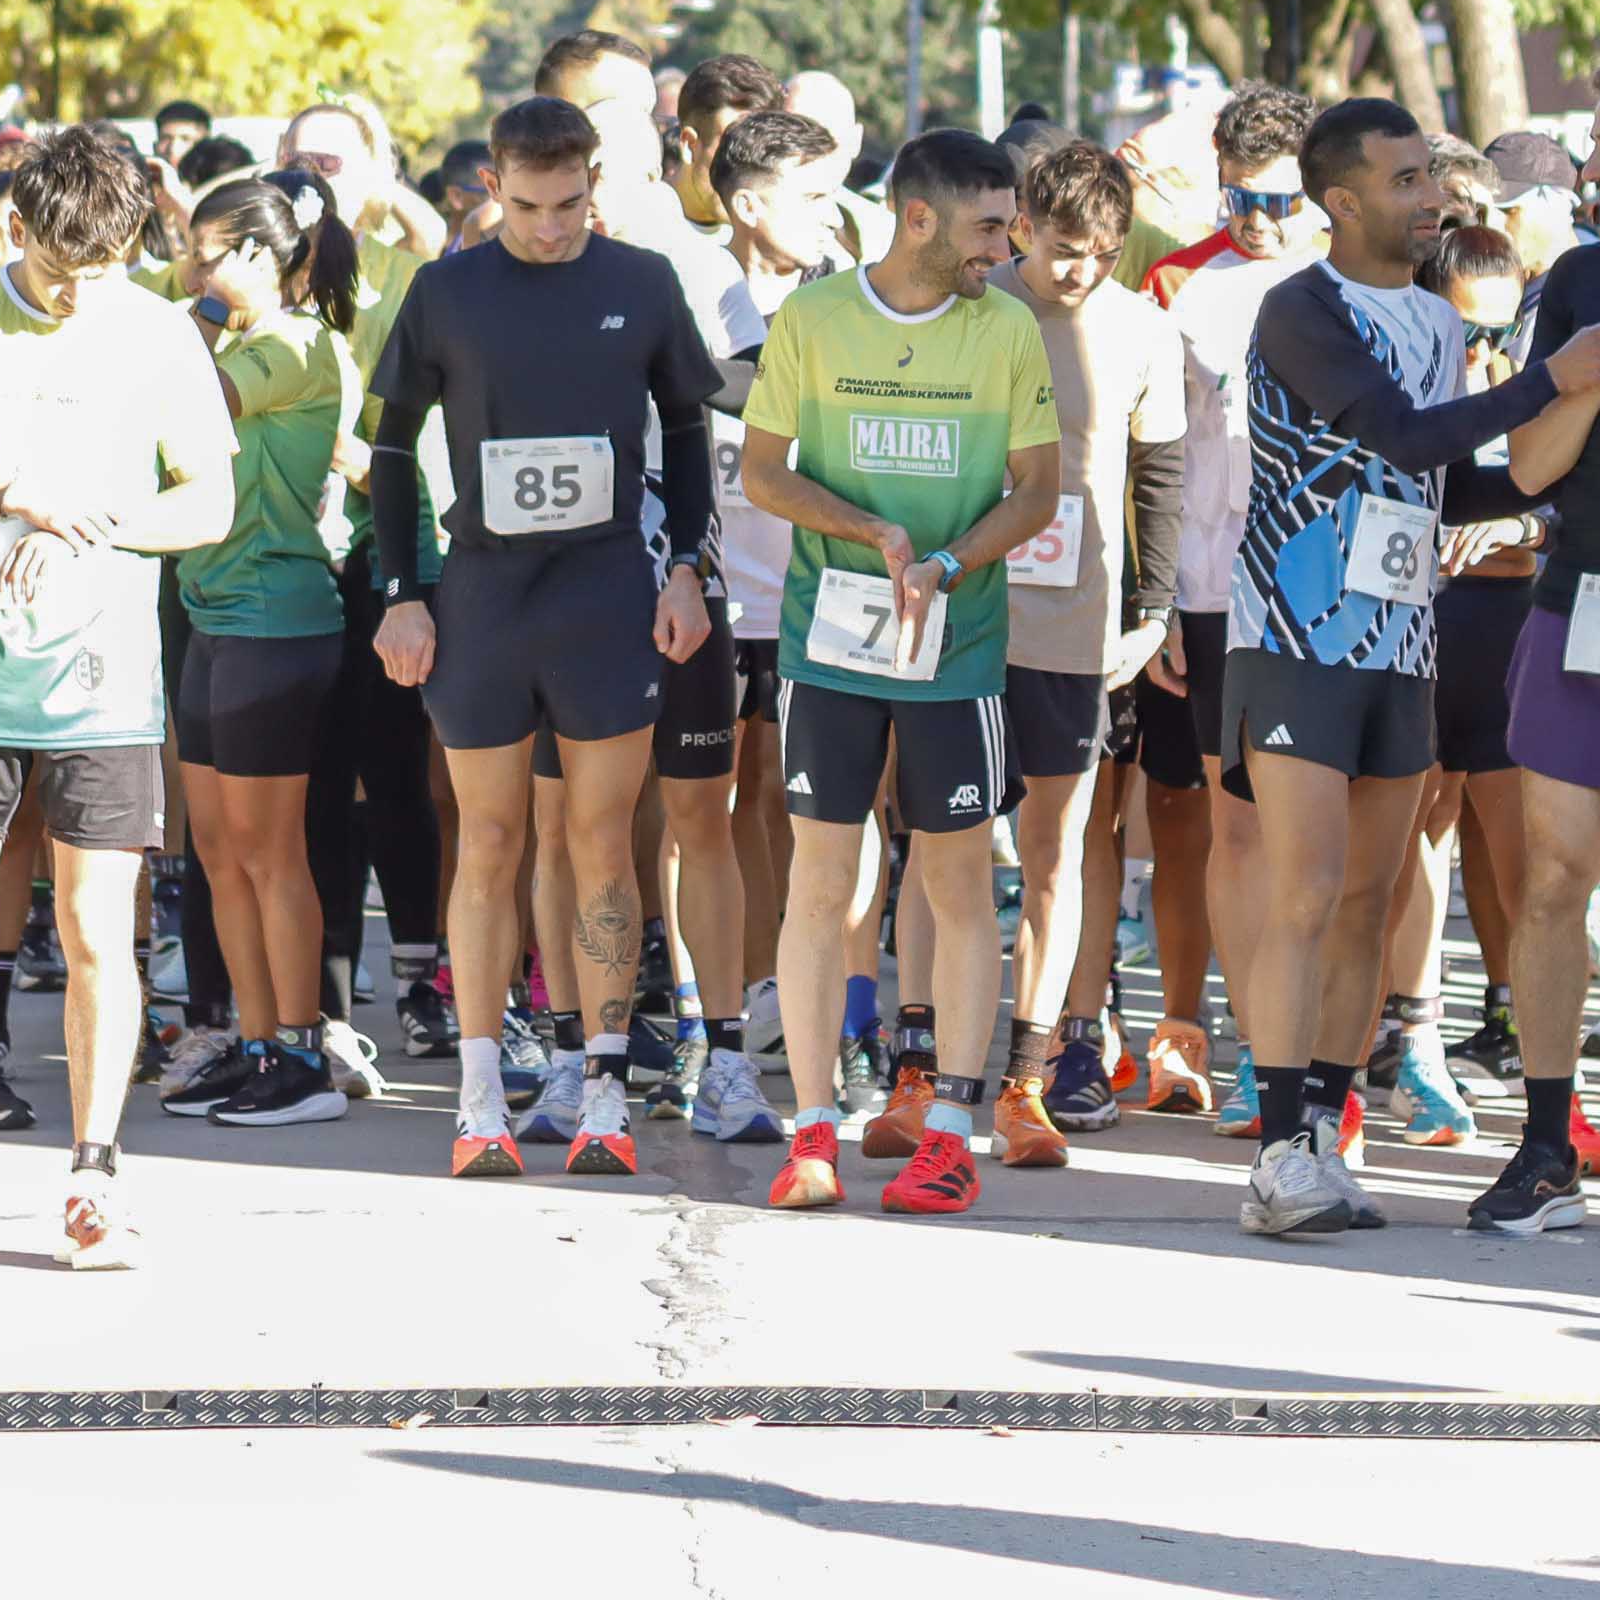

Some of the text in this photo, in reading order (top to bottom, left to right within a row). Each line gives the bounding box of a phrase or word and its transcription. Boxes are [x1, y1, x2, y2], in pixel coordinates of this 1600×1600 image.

[856, 419, 952, 461] MAIRA
[514, 464, 582, 511] 85
[861, 603, 892, 650] 7
